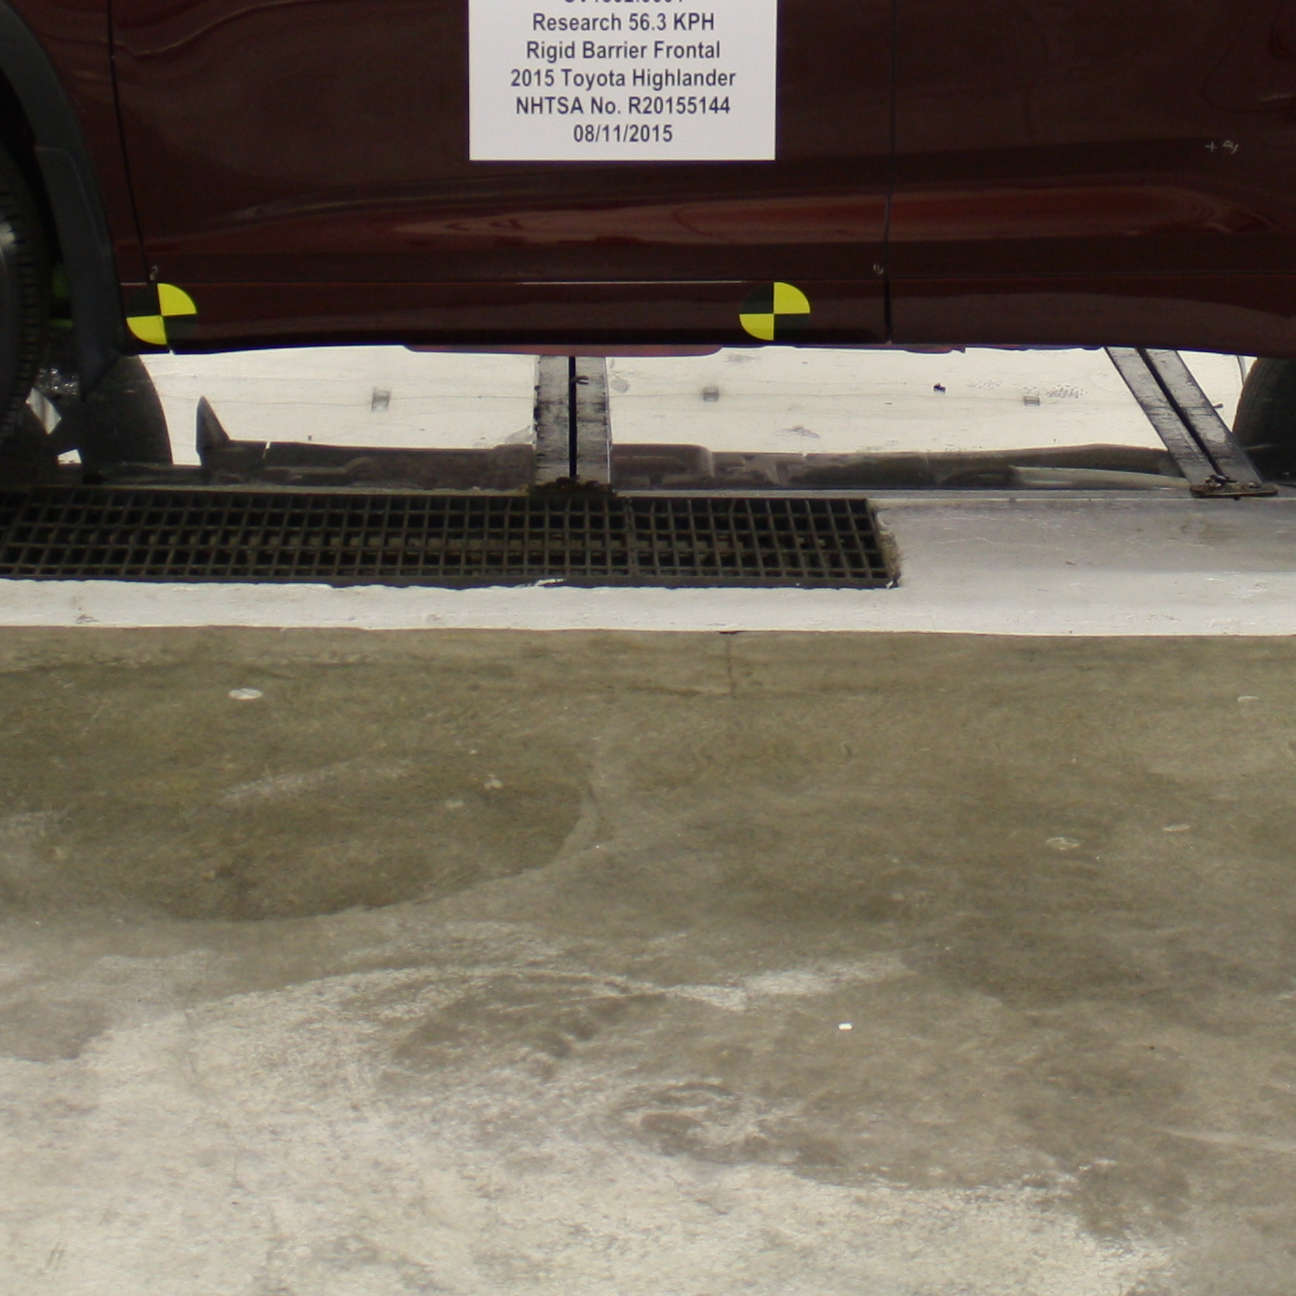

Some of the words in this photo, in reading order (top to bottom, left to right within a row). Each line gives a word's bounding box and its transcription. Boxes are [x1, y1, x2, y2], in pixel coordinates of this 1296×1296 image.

[533, 12, 622, 31] Research
[628, 12, 667, 31] 56.3
[673, 12, 715, 31] KPH
[526, 40, 576, 62] Rigid
[582, 40, 648, 60] Barrier
[653, 40, 721, 60] Frontal
[510, 68, 555, 87] 2015
[560, 68, 627, 90] Toyota
[631, 68, 737, 90] Highlander
[515, 96, 585, 115] NHTSA
[590, 96, 622, 115] No.
[628, 96, 731, 115] R20155144
[572, 124, 674, 143] 08/11/2015
